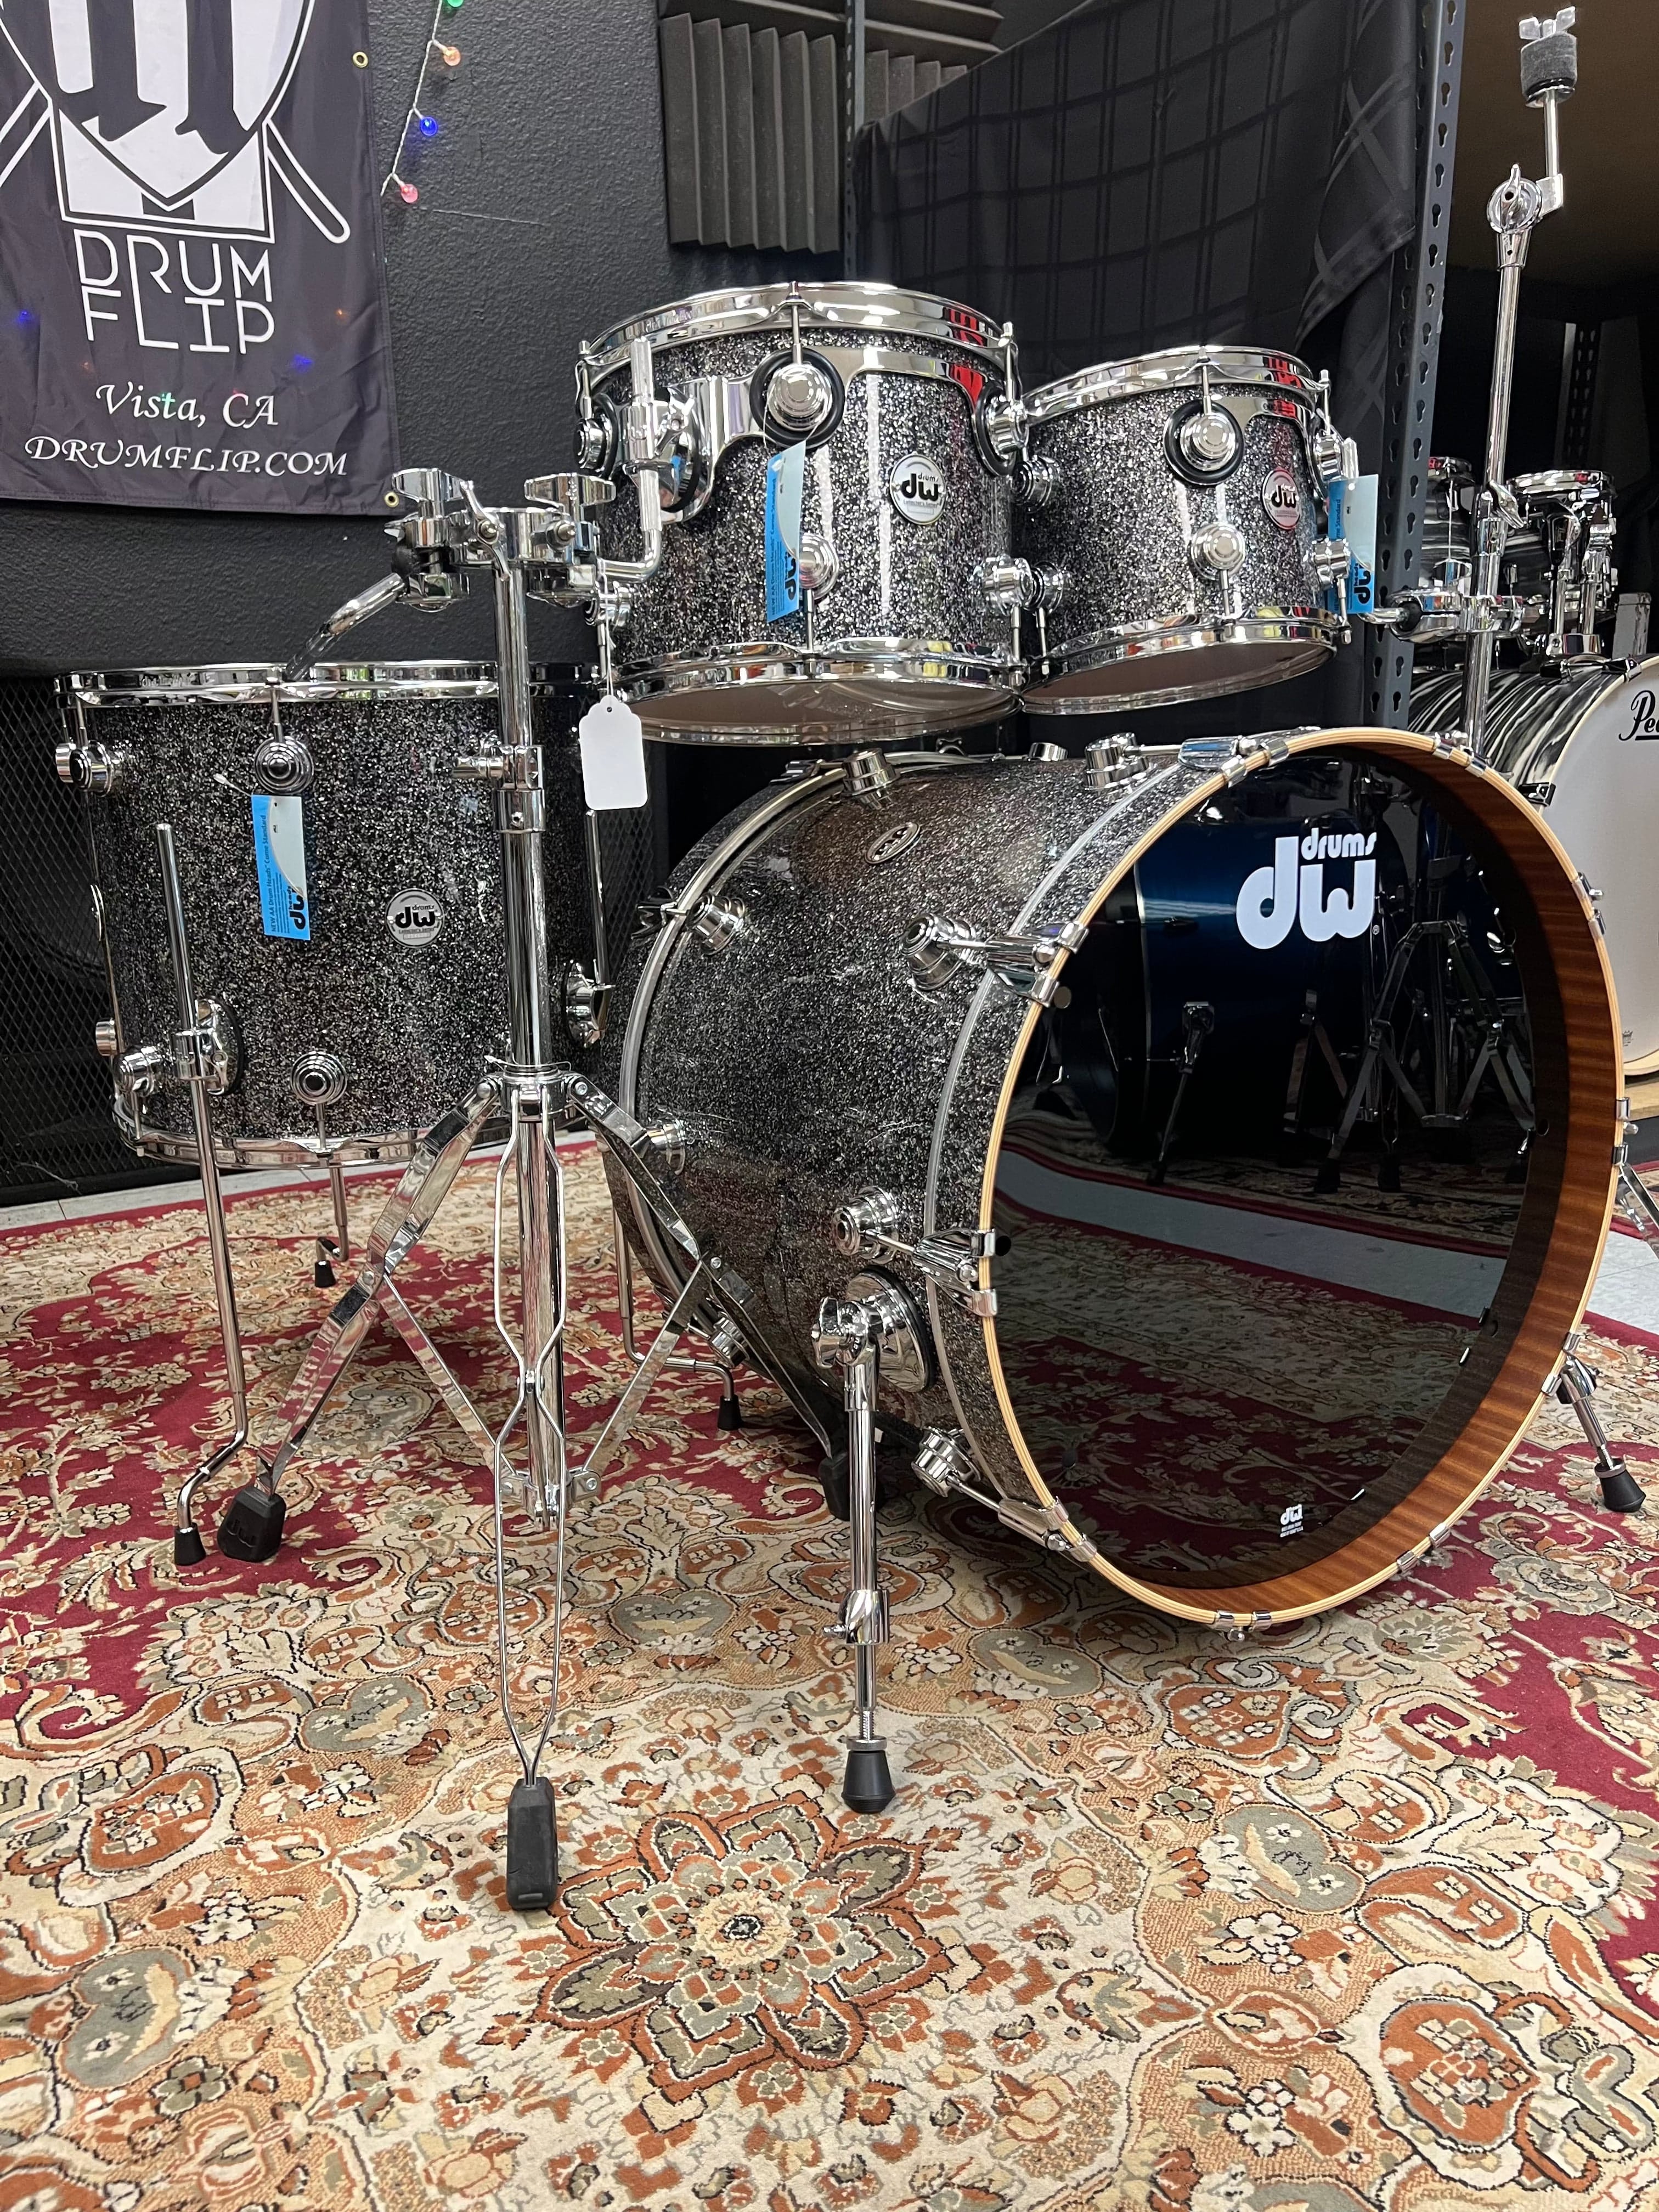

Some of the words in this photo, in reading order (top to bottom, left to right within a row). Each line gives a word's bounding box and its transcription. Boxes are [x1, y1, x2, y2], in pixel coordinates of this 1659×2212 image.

[74, 228, 273, 302] DRUM
[81, 285, 275, 354] FLIP
[95, 381, 206, 428] Vista,
[222, 393, 278, 428] CA
[25, 436, 348, 476] DRUMFLIP.COM
[901, 473, 939, 501] dw
[1271, 486, 1296, 509] dw
[1618, 690, 1659, 741] Pe
[1301, 827, 1377, 860] drums
[268, 906, 275, 916] AA
[1236, 836, 1376, 949] dw
[395, 906, 436, 928] dw
